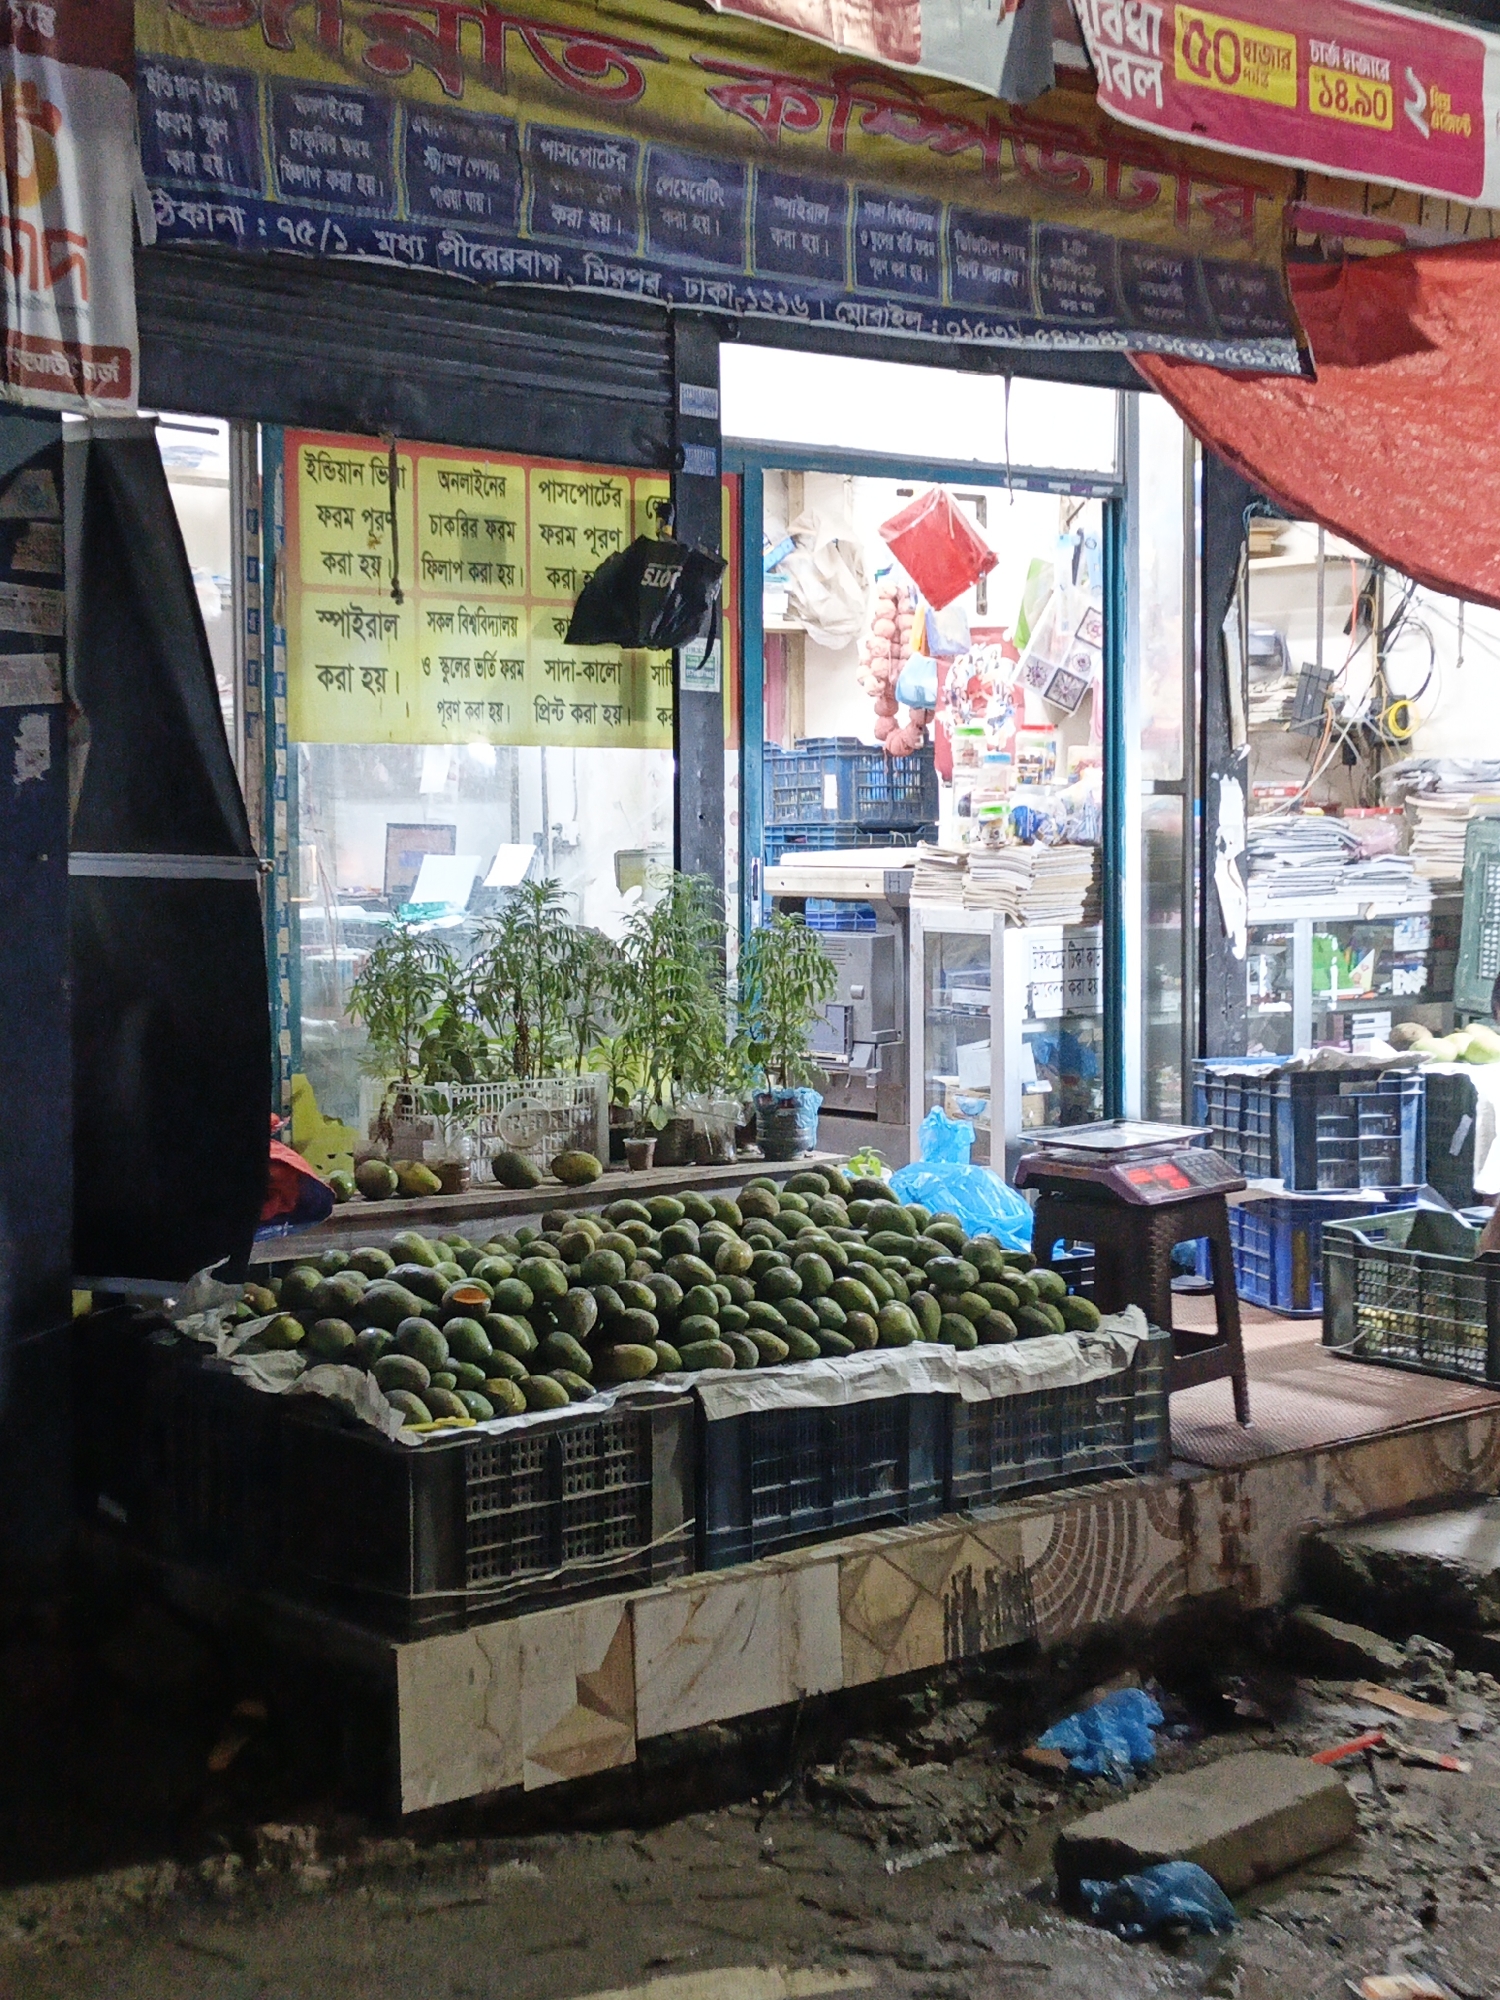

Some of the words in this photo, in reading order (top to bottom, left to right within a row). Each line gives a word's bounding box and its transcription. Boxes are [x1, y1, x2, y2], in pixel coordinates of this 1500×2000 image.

[1243, 38, 1292, 71] হাজার
[1309, 39, 1340, 67] চার্জ
[1343, 48, 1391, 82] হাজারে
[1093, 42, 1163, 109] াবল
[540, 139, 628, 173] পাসপোর্টের
[690, 53, 1278, 248] কম্পিউটার
[325, 169, 352, 193] করা
[550, 203, 584, 230] করা
[769, 227, 796, 250] করা
[151, 187, 246, 235] ঠিকানা
[372, 229, 428, 261] মধ্য
[835, 296, 924, 335] মোবাইল
[305, 452, 363, 482] ইন্ডিয়ান
[371, 456, 406, 491] ভিা
[438, 469, 506, 500] অনলাইনের
[538, 476, 622, 509] পাসপোর্টের
[317, 503, 354, 530] ফরম
[361, 507, 395, 540] পূরণ
[429, 510, 478, 540] চাকরির
[486, 517, 516, 543] ফরম
[539, 522, 576, 547] ফরম
[584, 527, 622, 557] পূরণ
[322, 551, 352, 576] করা
[422, 554, 463, 583] ফিলাপ
[468, 563, 493, 585] করা
[546, 566, 576, 587] করা
[317, 602, 400, 642] স্পাইরাল
[427, 609, 454, 633] সকল
[458, 604, 518, 637] বিশ্ববিদ্যালয়
[317, 664, 355, 692] করা
[422, 658, 431, 678] ও
[439, 657, 471, 682] স্কুলের
[474, 651, 497, 679] ভর্তি
[500, 658, 525, 681] ফরম
[544, 657, 622, 685] সাদা-কালো
[437, 700, 460, 730] পূরণ
[465, 704, 485, 728] করা
[533, 693, 566, 727] প্রিন্ট
[570, 703, 598, 728] করা
